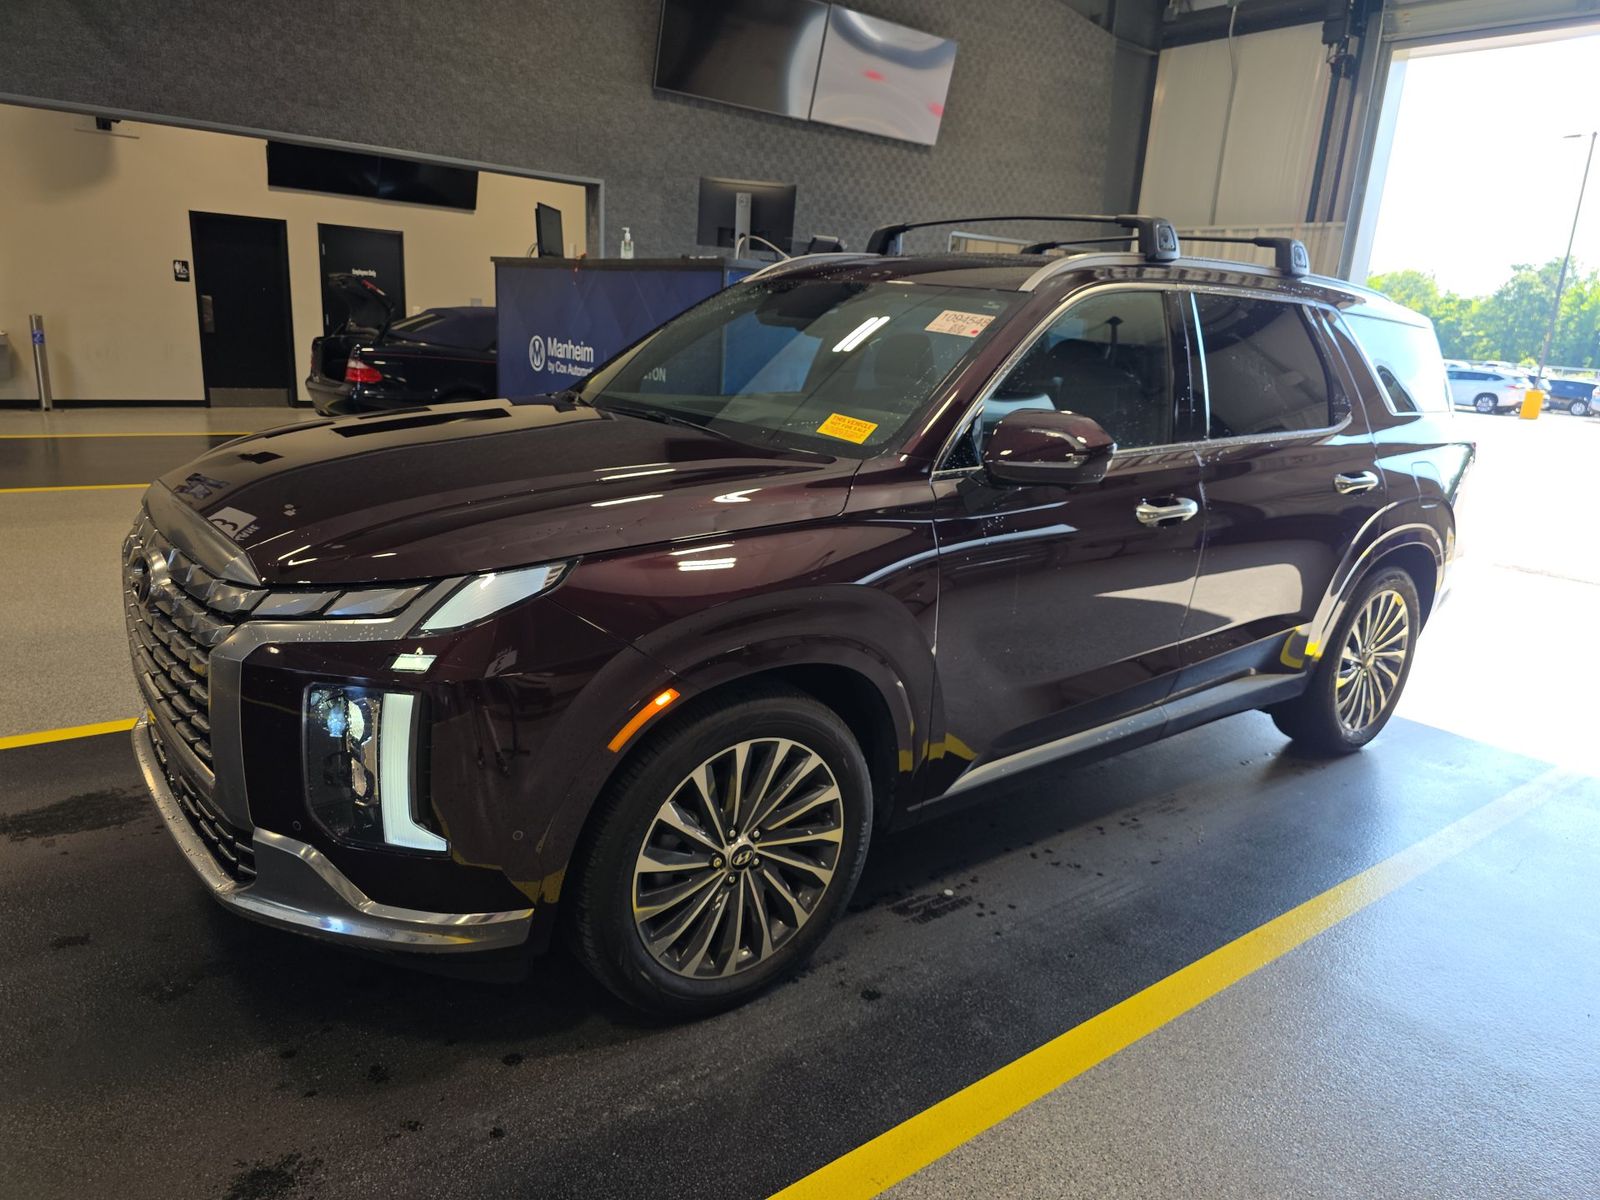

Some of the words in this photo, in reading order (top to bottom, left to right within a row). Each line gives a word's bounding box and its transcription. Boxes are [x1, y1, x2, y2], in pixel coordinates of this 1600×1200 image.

[547, 337, 594, 363] Manheim
[547, 361, 555, 374] by
[555, 361, 567, 373] Cox
